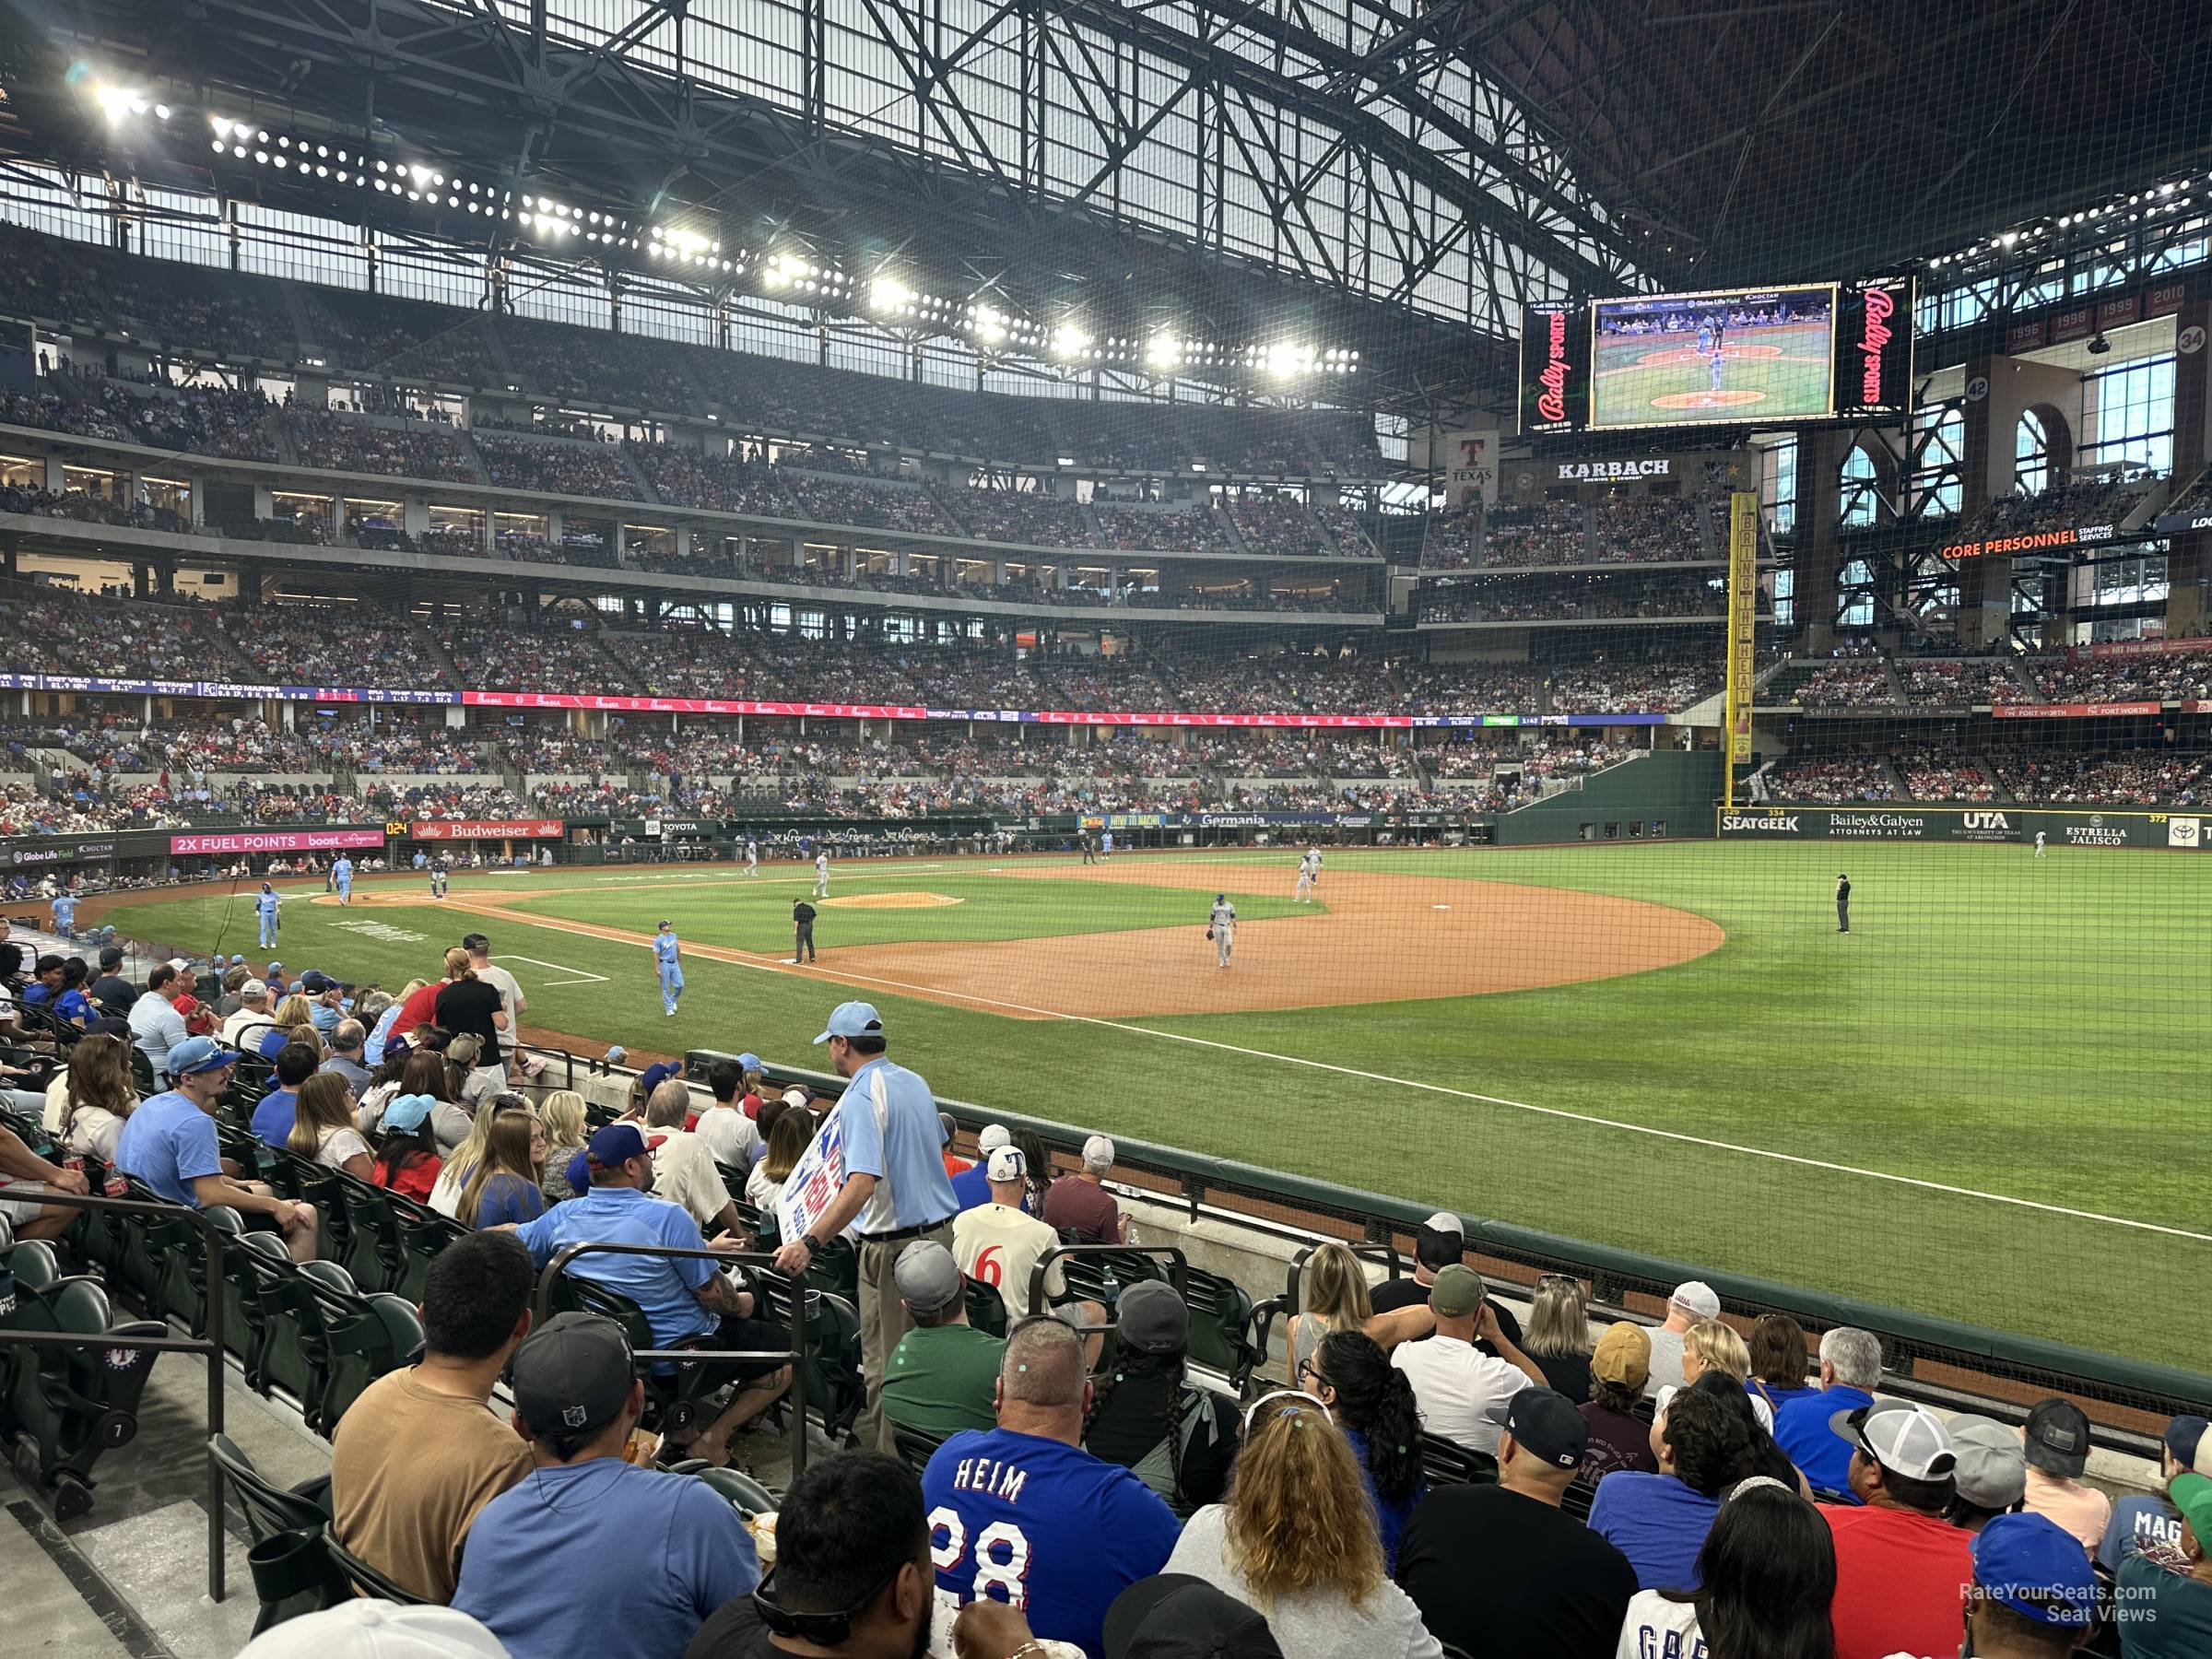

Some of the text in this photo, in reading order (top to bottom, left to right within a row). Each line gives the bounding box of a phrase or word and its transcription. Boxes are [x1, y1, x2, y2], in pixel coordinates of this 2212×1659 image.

[2154, 285, 2184, 303] 2010
[2103, 298, 2133, 317] 1999
[2058, 311, 2086, 328] 1998
[2012, 324, 2039, 341] 1996
[2181, 328, 2203, 349] 34
[1857, 289, 1894, 403] Bally SPORTS
[1538, 312, 1571, 421] Bally SPORTS
[1968, 381, 1985, 395] 42
[1461, 439, 1485, 468] T
[1453, 470, 1492, 482] TEXAS
[1558, 459, 1670, 479] KARBACH
[2078, 524, 2113, 536] STAFFING
[2078, 531, 2112, 543] SERVICES
[1943, 530, 2078, 560] CORE PERSONNEL
[1740, 516, 1752, 701] BRING THE HEAT
[662, 823, 698, 831] TOYOTA
[1202, 814, 1265, 825] Germania
[1723, 816, 1799, 831] SEATGEEK
[1830, 814, 1924, 829] Bailey&Galyen
[1963, 812, 2009, 830] UTA
[386, 822, 407, 835] 024
[451, 824, 529, 838] Budweiser
[2066, 827, 2127, 838] ESTRELLA
[177, 836, 296, 851] 2X FUEL POINTS
[2070, 835, 2121, 846] JALISCO
[24, 852, 44, 862] Globe
[45, 850, 58, 860] Life
[58, 849, 74, 859] Field
[804, 1169, 832, 1225] HEIM
[975, 1245, 1003, 1289] 6
[679, 1411, 686, 1423] 5
[114, 1424, 123, 1438] 7
[954, 1458, 1027, 1503] HEIM
[2135, 1511, 2183, 1544] MAG
[926, 1506, 1032, 1614] 28
